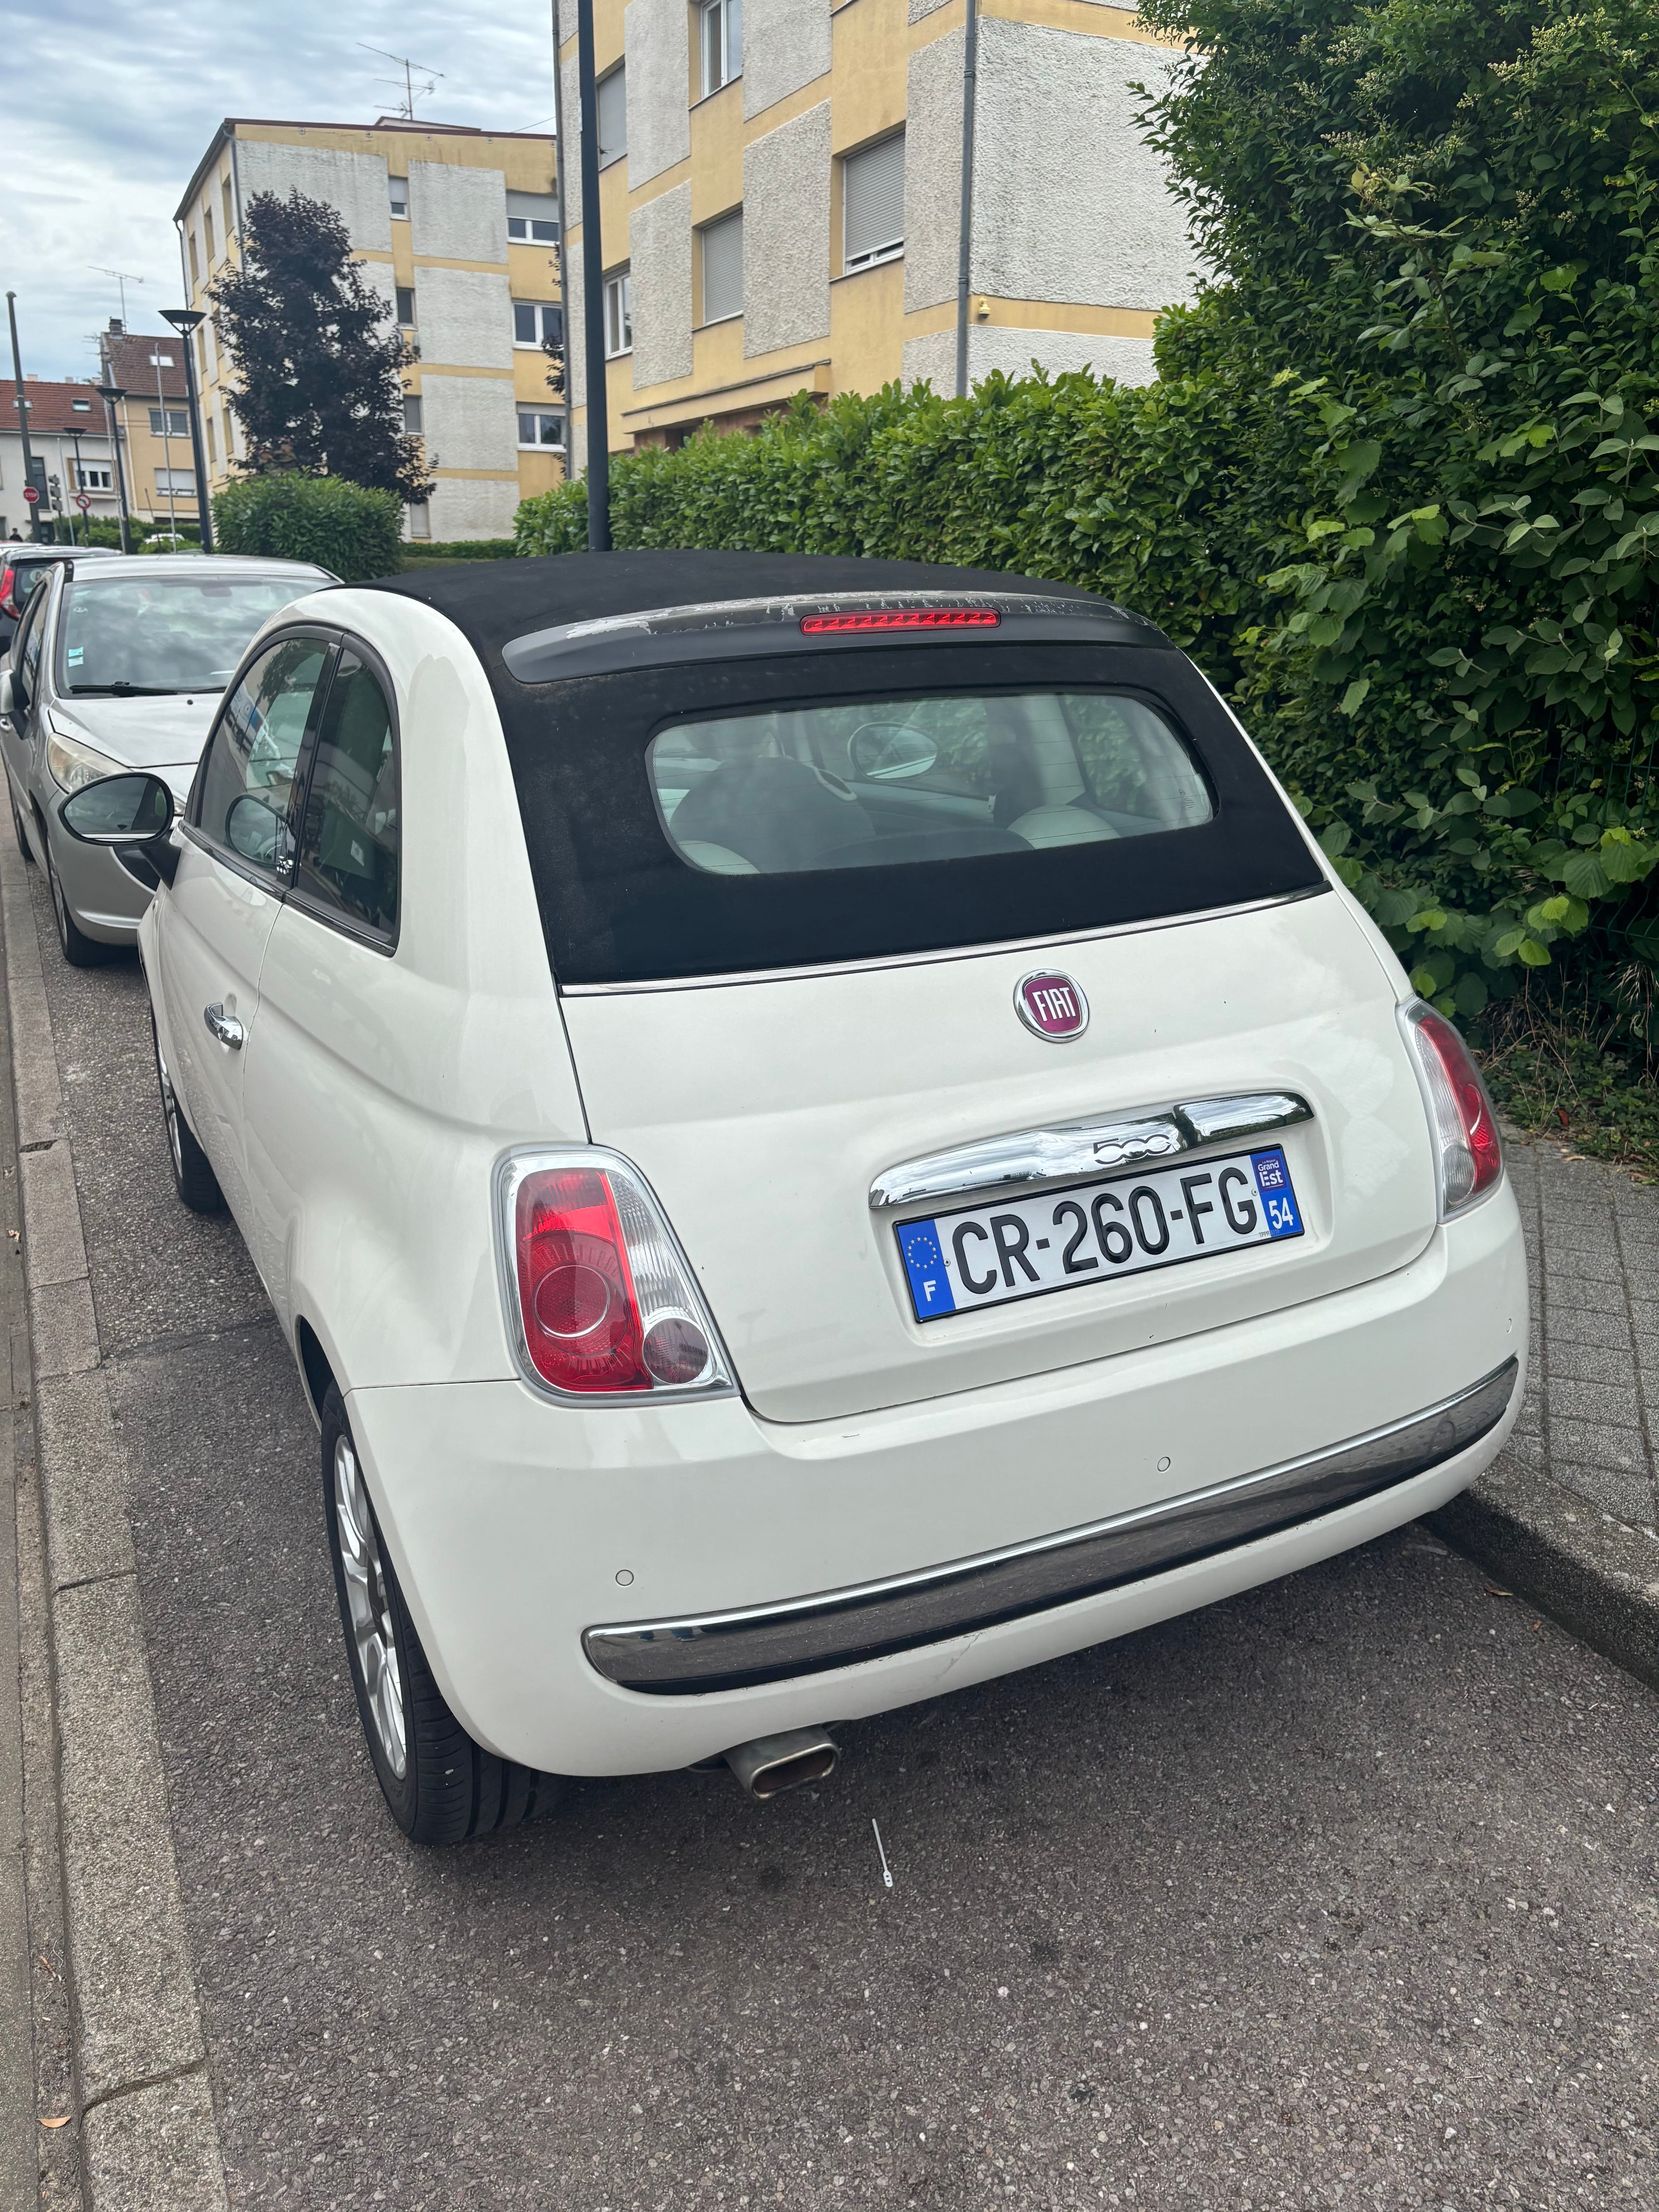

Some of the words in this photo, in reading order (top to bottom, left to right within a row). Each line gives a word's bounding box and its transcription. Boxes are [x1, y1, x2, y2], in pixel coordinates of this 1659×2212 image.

[1032, 987, 1076, 1022] FIAT
[1093, 1134, 1172, 1164] 500
[1258, 1160, 1279, 1171] Grand
[1259, 1170, 1283, 1187] Est
[1268, 1197, 1293, 1229] 54
[952, 1167, 1257, 1294] CR-260-FG
[923, 1280, 936, 1301] F
